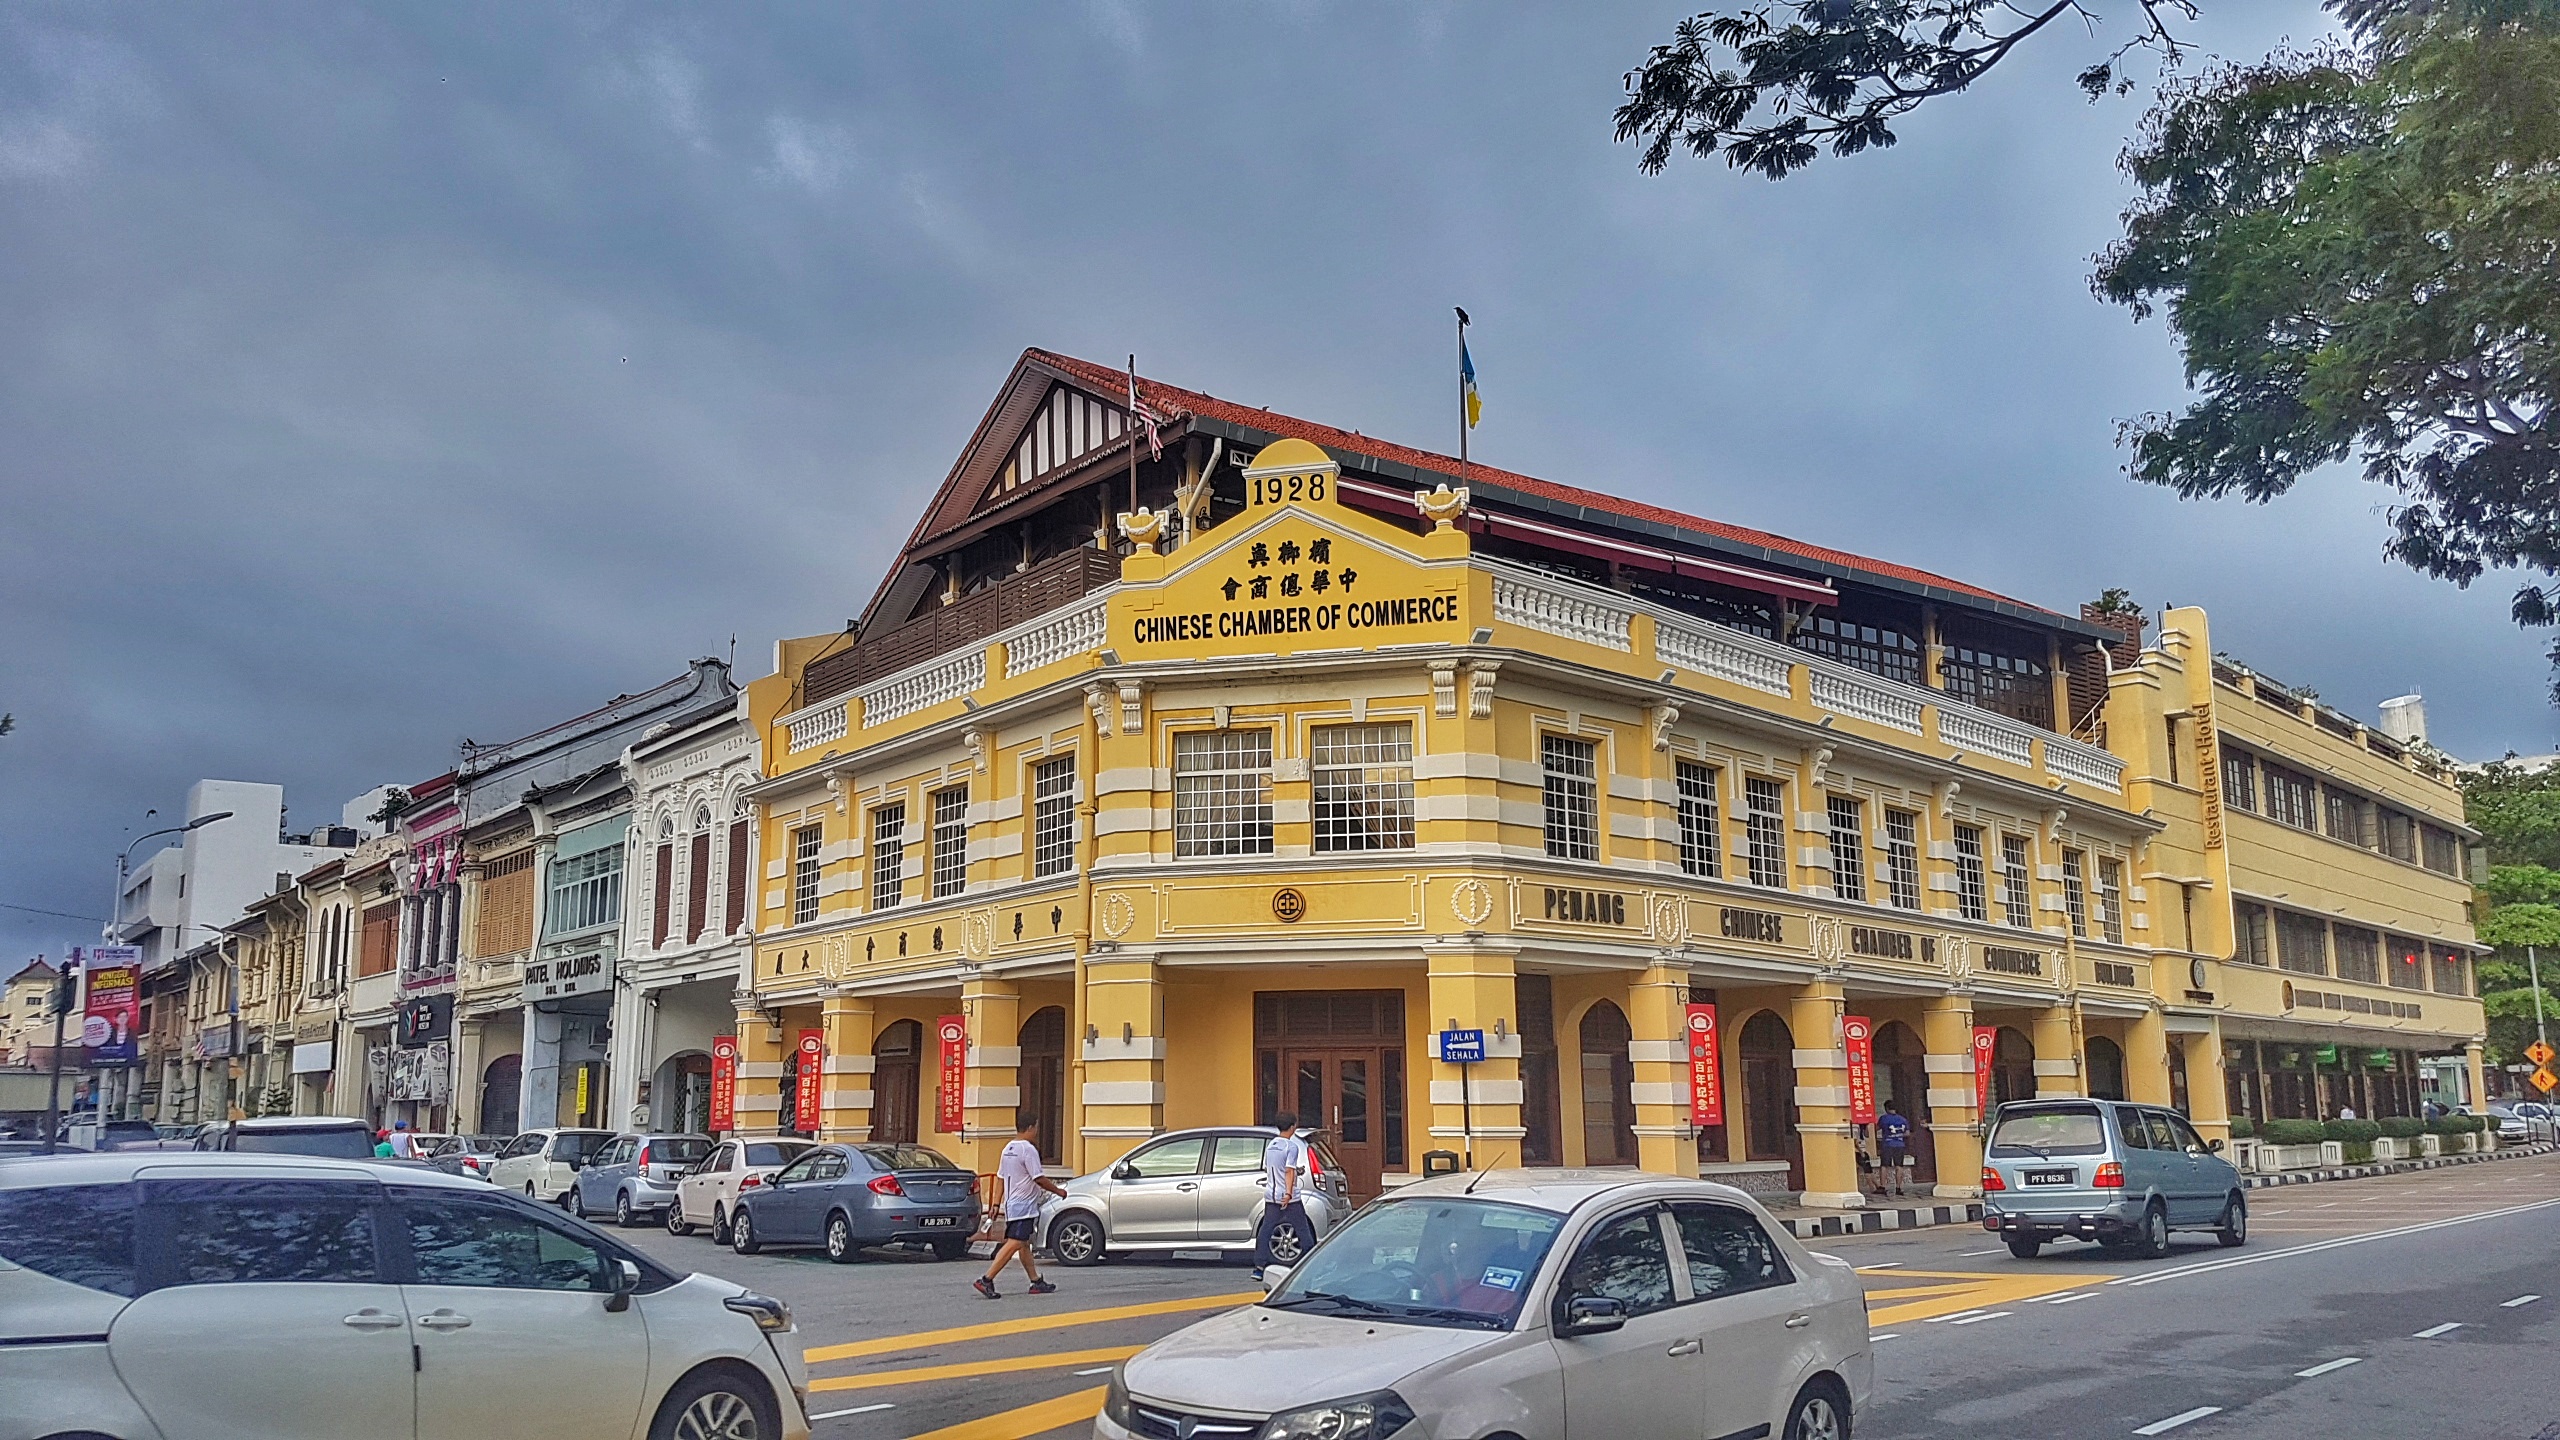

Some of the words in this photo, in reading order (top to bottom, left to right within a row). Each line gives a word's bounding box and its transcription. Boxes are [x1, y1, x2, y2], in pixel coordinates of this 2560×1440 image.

[1252, 473, 1325, 506] 1928
[1134, 613, 1213, 643] CHINESE
[1218, 606, 1311, 637] CHAMBER
[1316, 604, 1341, 630] OF
[1347, 595, 1457, 628] COMMERCE
[2192, 702, 2213, 749] Hotel
[2200, 757, 2222, 850] Restaurant
[1544, 888, 1624, 924] PENANG
[1719, 907, 1783, 942] CHINESE
[1850, 926, 1913, 959] CHAMBER
[1920, 936, 1935, 962] OF
[1983, 945, 2043, 976] COMMERCE
[2093, 961, 2135, 987] BUILDING
[525, 964, 549, 985] PATEL
[556, 953, 601, 980] HOLDINGS
[1449, 1032, 1475, 1042] JALAN
[1447, 1051, 1479, 1060] SEHALA
[2031, 1174, 2046, 1183] PFX
[2047, 1173, 2066, 1183] 8636
